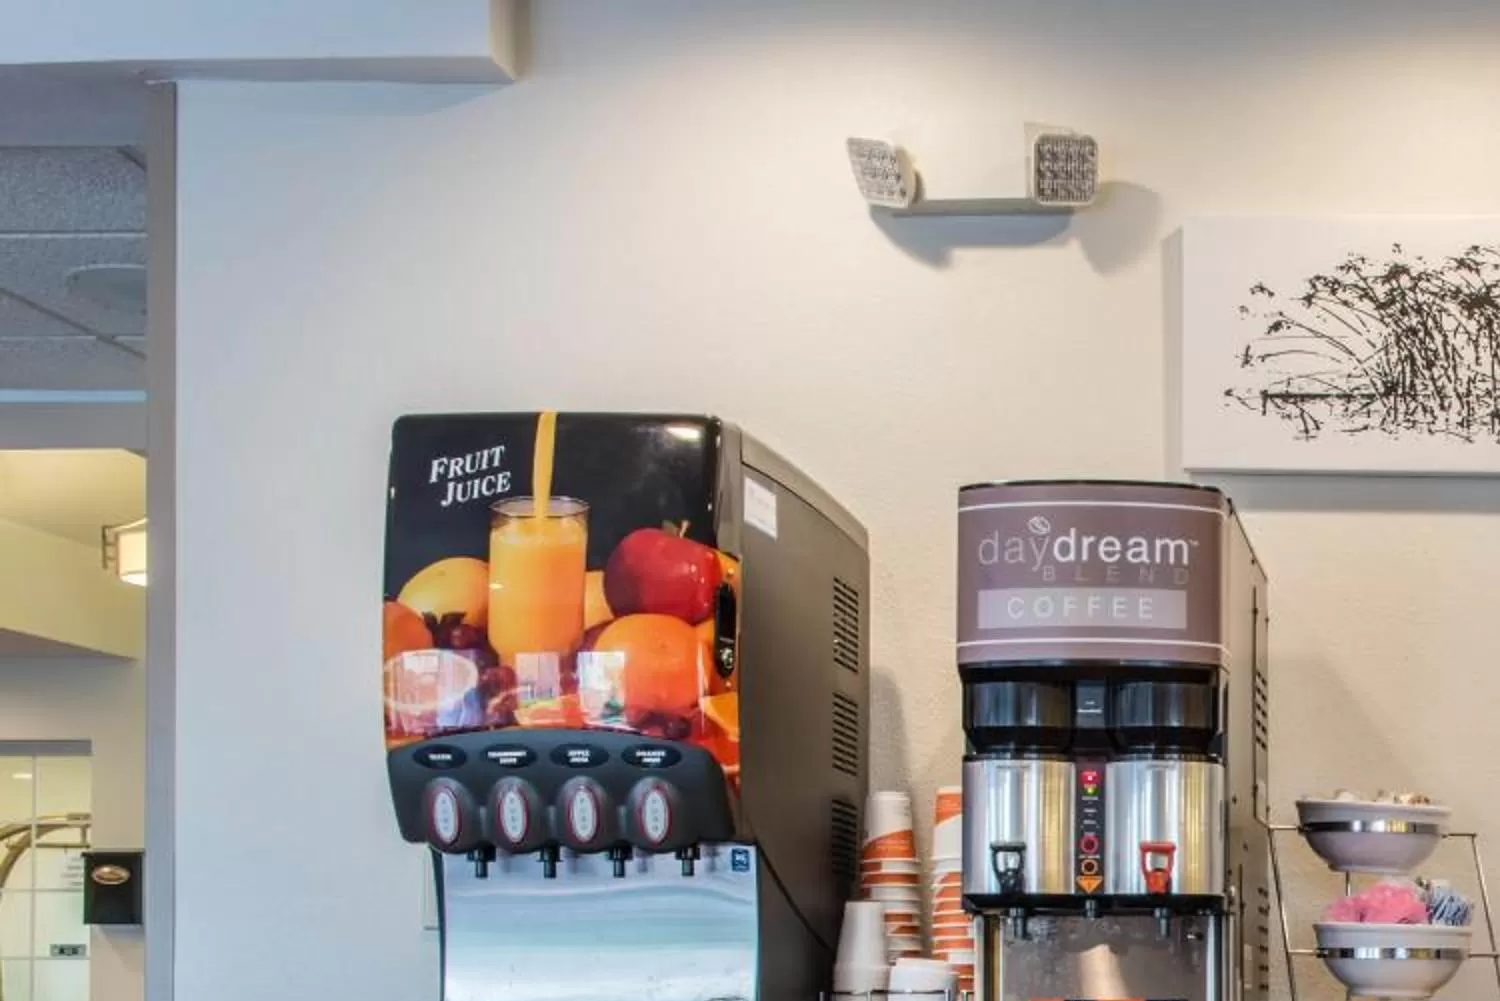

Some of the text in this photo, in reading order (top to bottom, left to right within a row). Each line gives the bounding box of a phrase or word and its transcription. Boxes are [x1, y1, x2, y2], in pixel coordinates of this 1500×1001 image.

[429, 445, 506, 484] FRUIT
[441, 471, 512, 507] JUICE
[1042, 565, 1190, 585] BLEND
[1007, 595, 1154, 619] COFFEE
